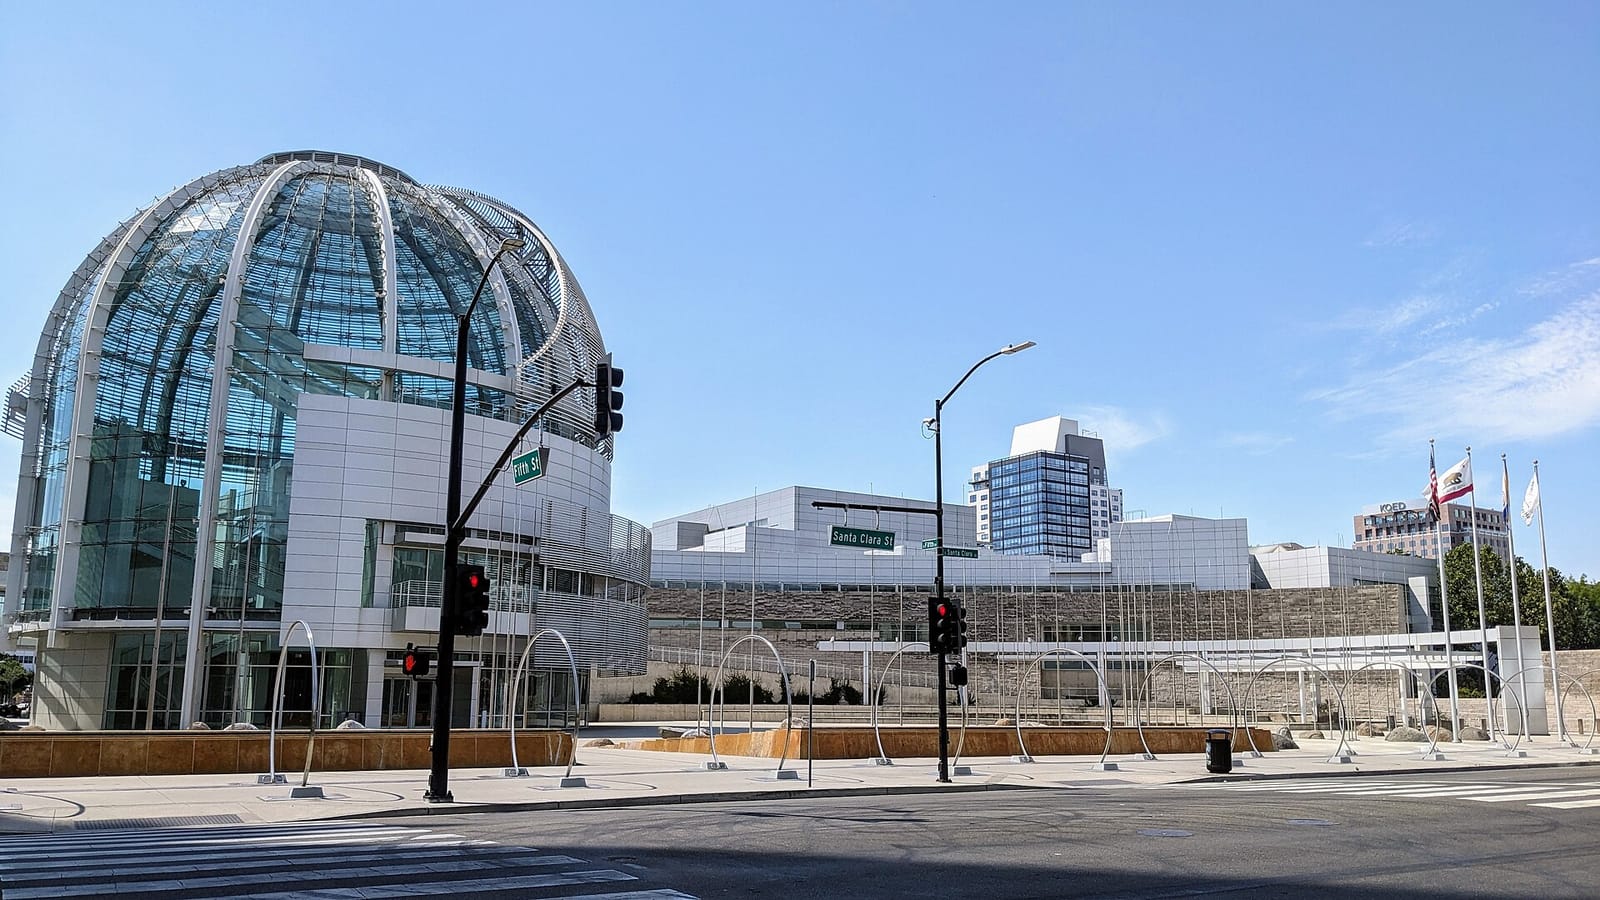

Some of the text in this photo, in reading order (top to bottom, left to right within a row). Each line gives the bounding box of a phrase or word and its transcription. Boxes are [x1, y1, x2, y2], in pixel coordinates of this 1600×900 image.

[514, 456, 540, 478] Fifth St
[833, 531, 893, 546] Santa Clara St
